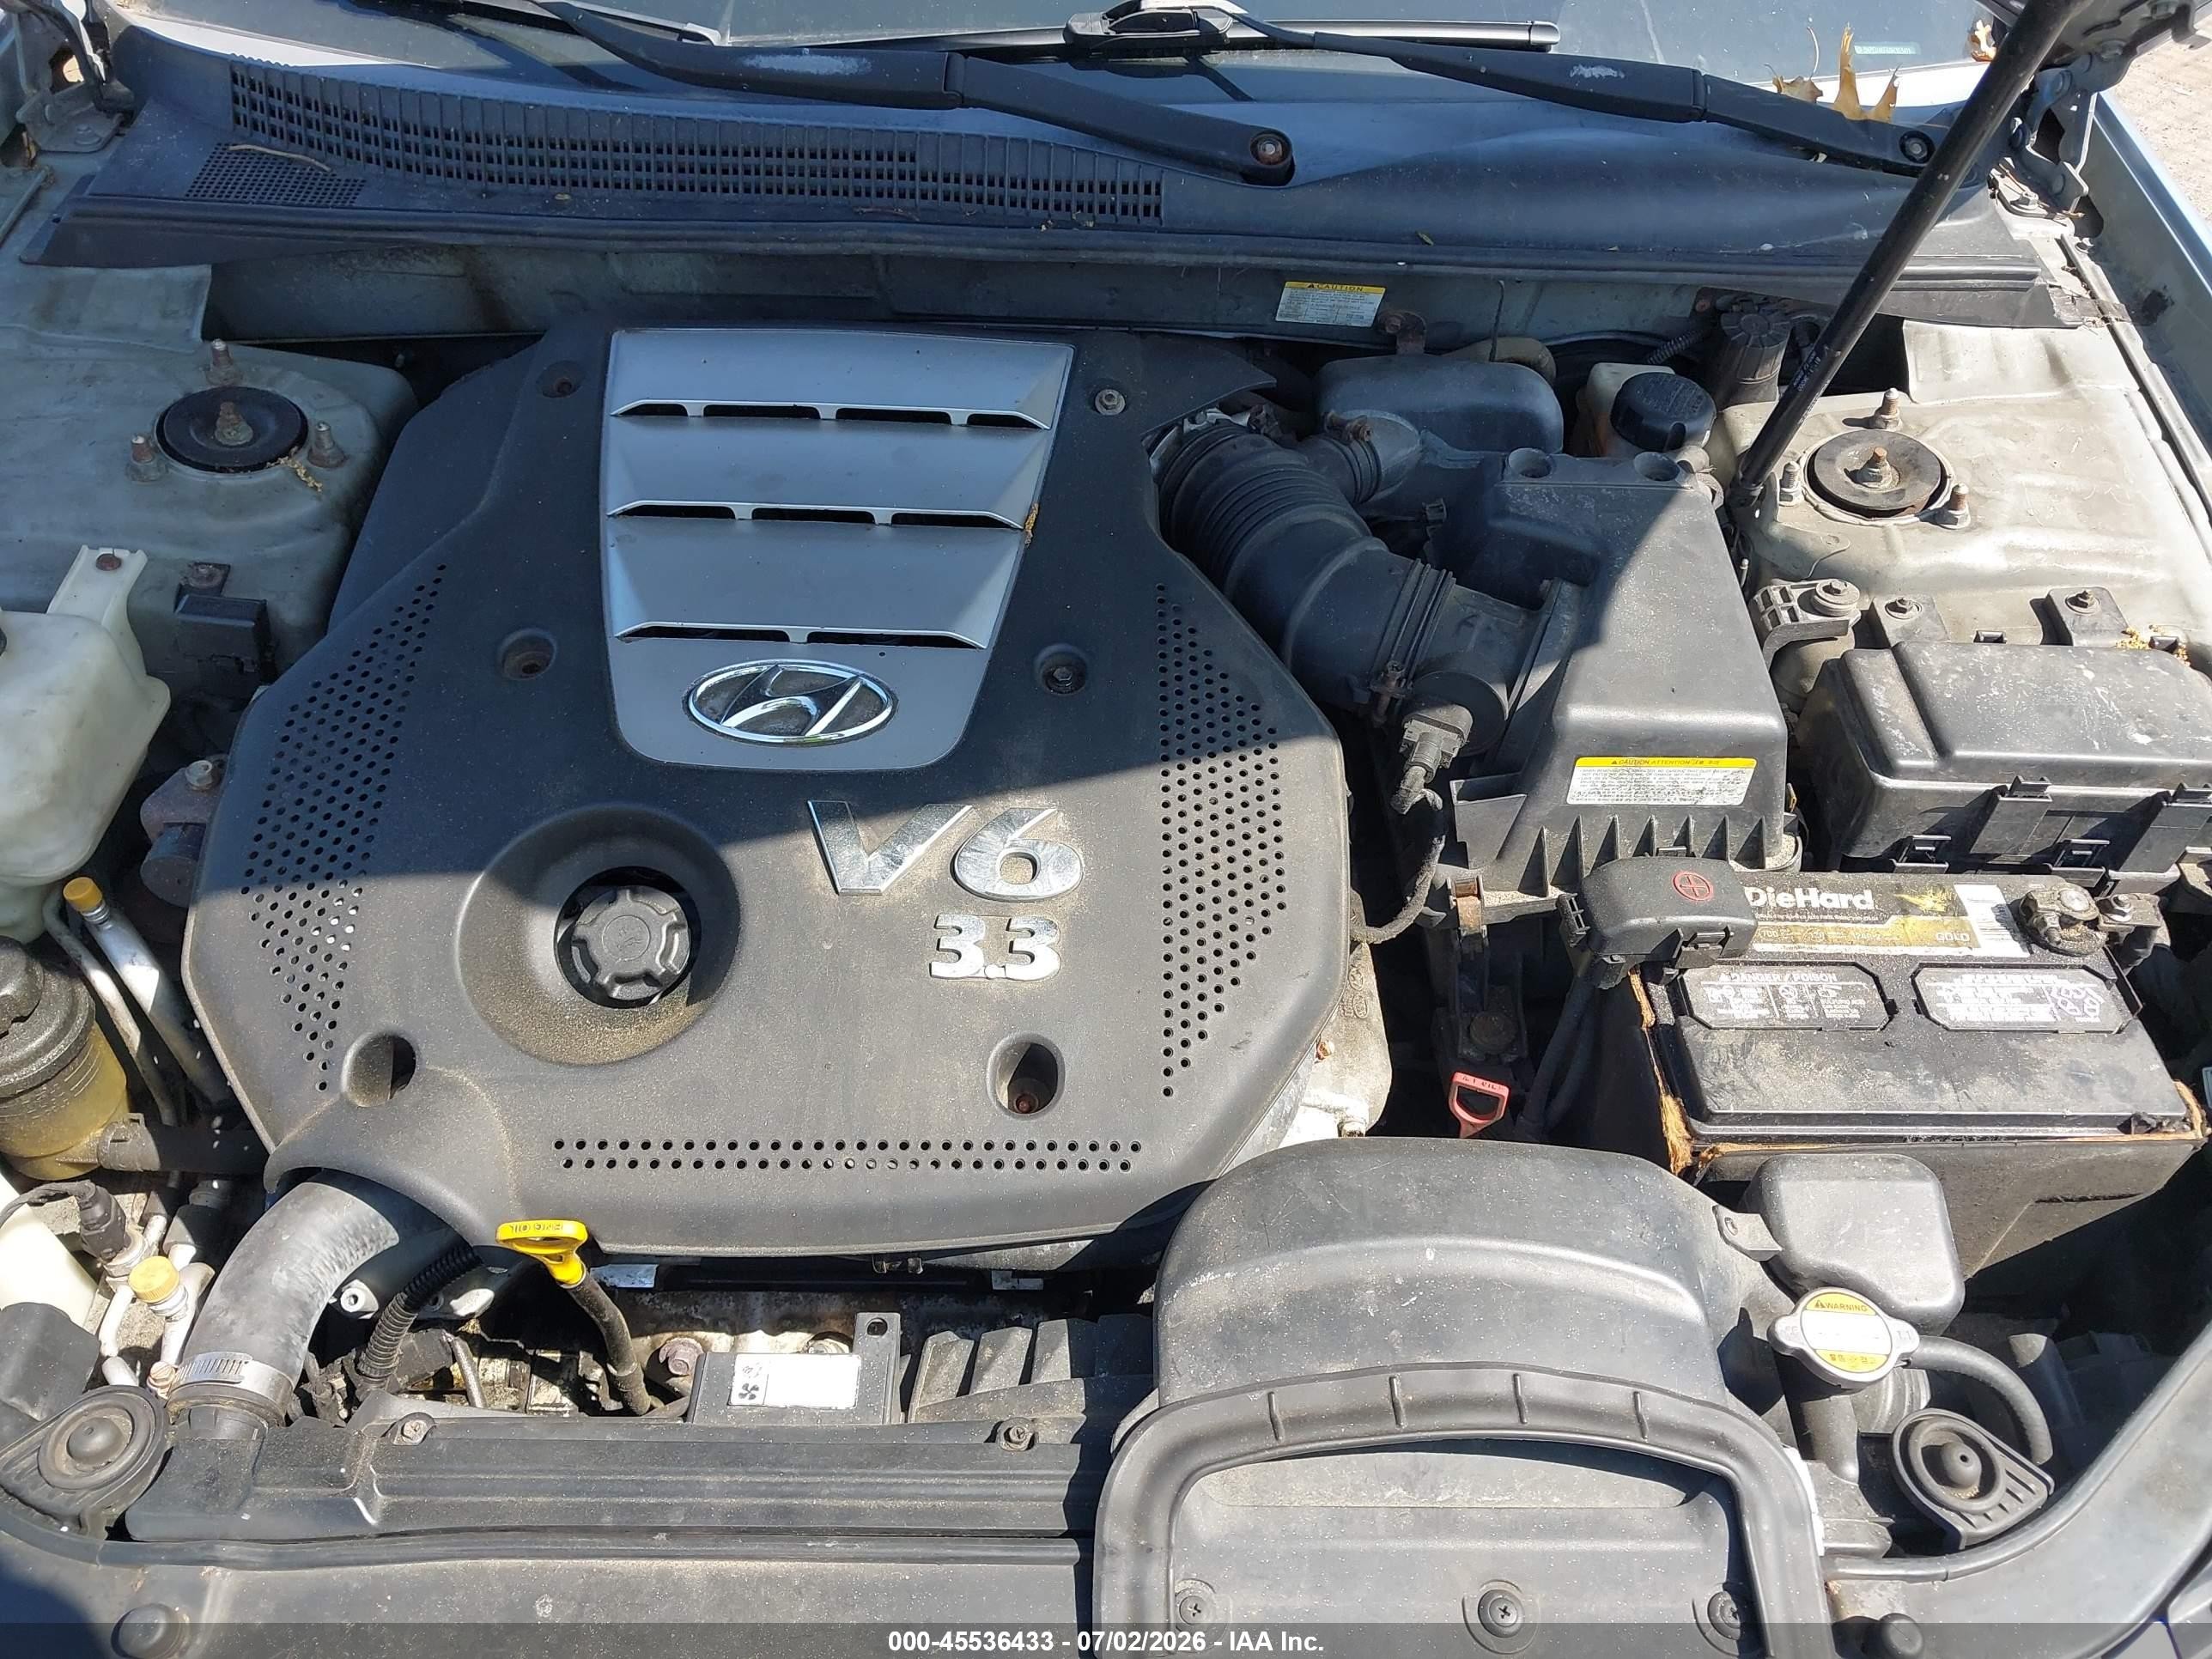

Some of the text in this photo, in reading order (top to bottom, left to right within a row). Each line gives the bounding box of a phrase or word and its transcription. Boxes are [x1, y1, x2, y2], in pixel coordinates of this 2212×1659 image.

[1317, 283, 1364, 292] CAUTION
[807, 799, 1085, 902] V6
[1744, 886, 1874, 910] DieHard
[1936, 932, 1970, 942] GOLD
[929, 914, 1062, 981] 3.3
[1730, 973, 1781, 982] DANGER
[1792, 973, 1838, 982] POISON
[509, 1223, 531, 1233] OIL
[1826, 1302, 1869, 1312] WARNING
